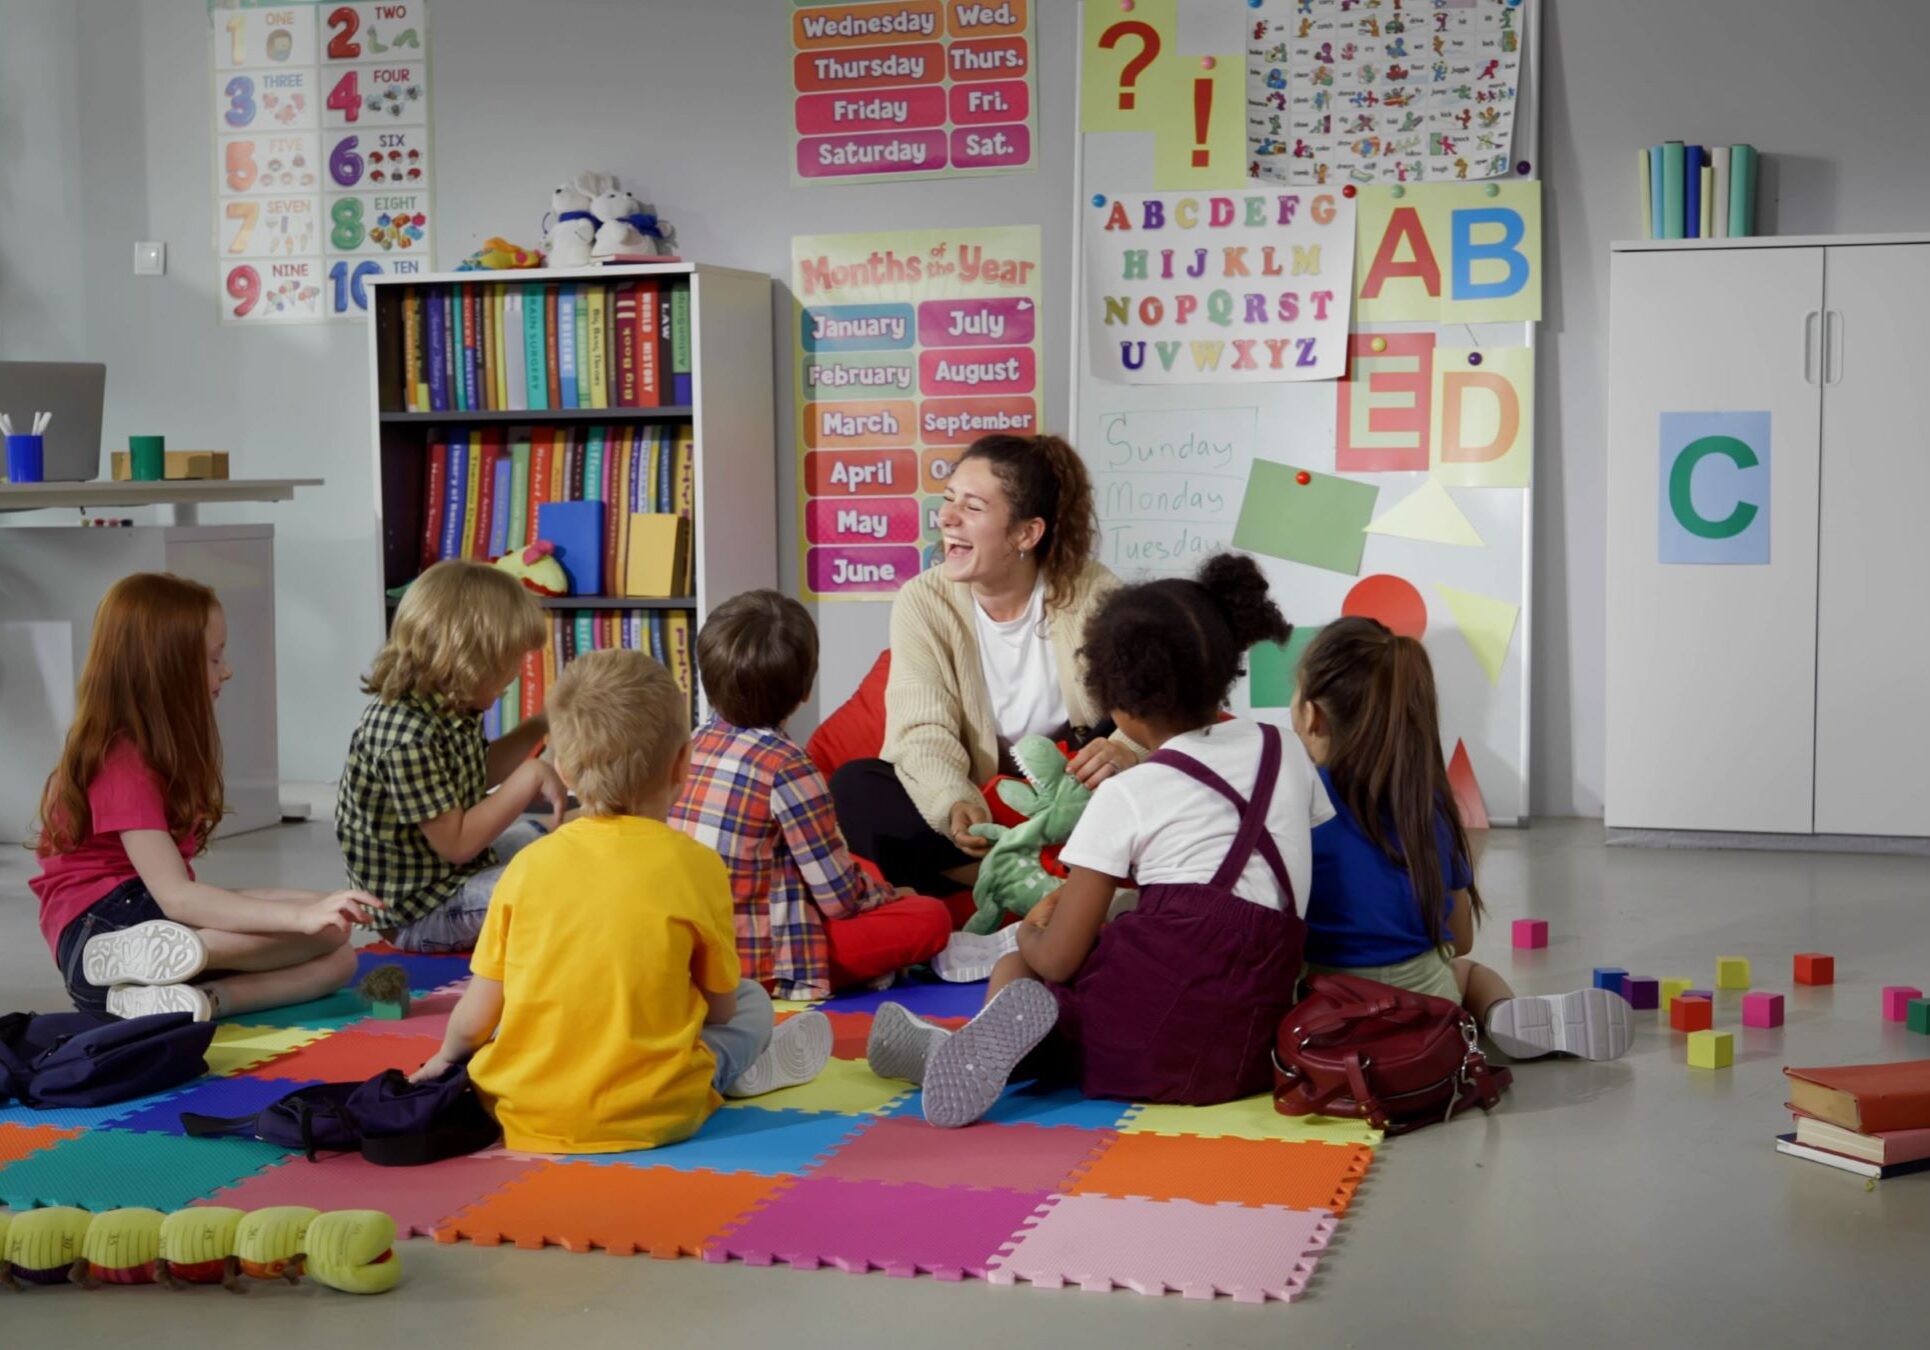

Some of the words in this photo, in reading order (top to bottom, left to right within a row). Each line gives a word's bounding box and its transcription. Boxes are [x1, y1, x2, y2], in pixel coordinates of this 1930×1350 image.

[265, 12, 294, 26] ONE
[375, 6, 406, 20] TWO
[803, 11, 935, 38] Wednesday
[956, 3, 1017, 27] Wed.
[327, 7, 361, 59] 2
[815, 54, 925, 80] Thursday
[951, 48, 1024, 70] Thurs.
[263, 74, 304, 88] THREE
[373, 69, 410, 83] FOUR
[225, 76, 256, 127] 3
[327, 70, 362, 123] 4
[834, 99, 908, 122] Friday
[968, 91, 1008, 112] Fri.
[270, 139, 303, 152] FIVE
[379, 135, 405, 147] SIX
[819, 141, 926, 165] Saturday
[966, 132, 1014, 156] Sat.
[226, 141, 257, 191] 5
[329, 135, 364, 186] 6
[267, 201, 311, 214] SEVEN
[375, 197, 417, 210] EIGHT
[226, 201, 260, 254] 7
[330, 197, 365, 250] 8
[930, 242, 947, 257] of
[1359, 207, 1441, 298] A
[1452, 207, 1530, 300] B
[272, 264, 309, 276] NINE
[393, 261, 419, 274] TEN
[802, 251, 921, 294] Months
[927, 261, 955, 278] the
[959, 244, 1035, 285] Year
[226, 264, 261, 317] 9
[641, 292, 653, 333] WORLD
[661, 302, 671, 340] LAW
[949, 309, 1004, 338] July
[561, 302, 573, 370] MEDICINE
[812, 316, 905, 339] January
[529, 333, 541, 391] SURGERY
[622, 327, 634, 369] Book
[642, 342, 654, 392] HISTORY
[809, 365, 911, 388] February
[935, 357, 1020, 384] August
[623, 372, 635, 401] Big
[1349, 355, 1420, 448] E
[822, 412, 898, 436] March
[924, 412, 1033, 436] September
[1441, 372, 1520, 463] D
[1106, 412, 1233, 470] Sunday
[830, 459, 893, 492] April
[1669, 435, 1759, 539] C
[1106, 480, 1224, 518] Monday
[837, 510, 888, 538] May
[1110, 525, 1226, 565] Tuesday
[832, 559, 895, 584] June
